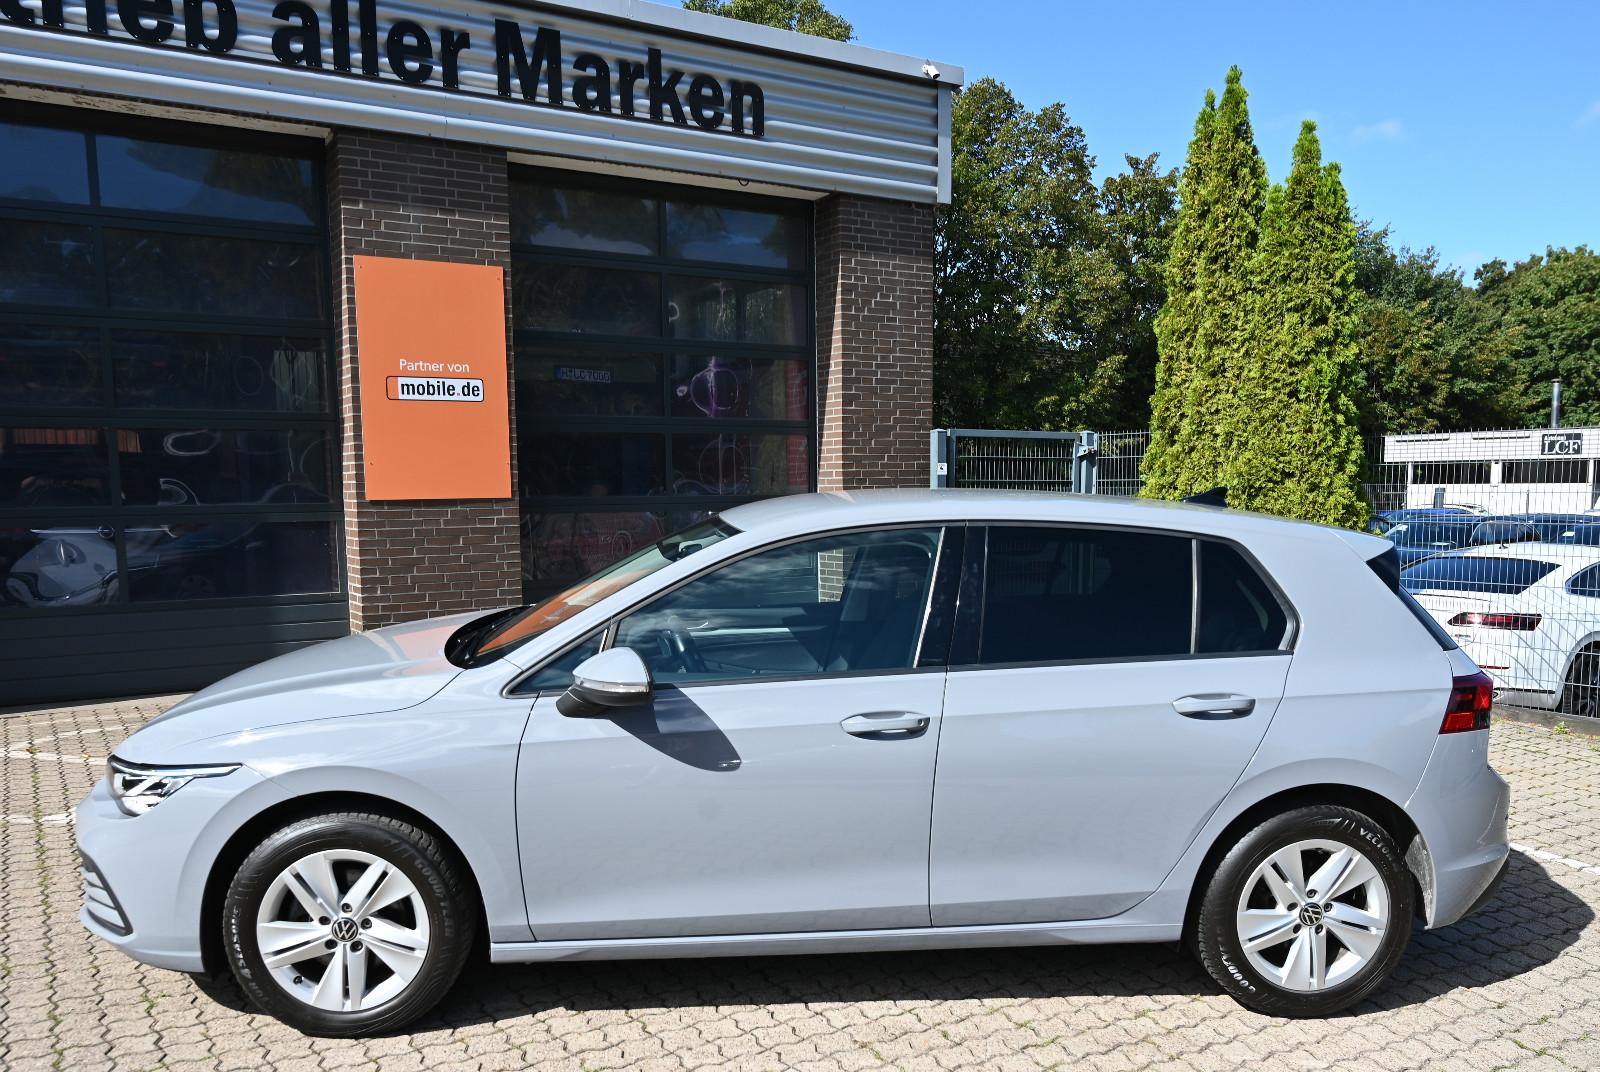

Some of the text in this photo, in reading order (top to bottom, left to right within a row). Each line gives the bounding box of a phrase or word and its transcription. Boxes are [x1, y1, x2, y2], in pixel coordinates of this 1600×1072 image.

[271, 0, 471, 89] aller
[494, 18, 765, 137] Marken
[399, 358, 470, 374] Partner von
[401, 381, 480, 397] mobile.de
[1543, 440, 1581, 454] LCF
[333, 918, 357, 942] VW
